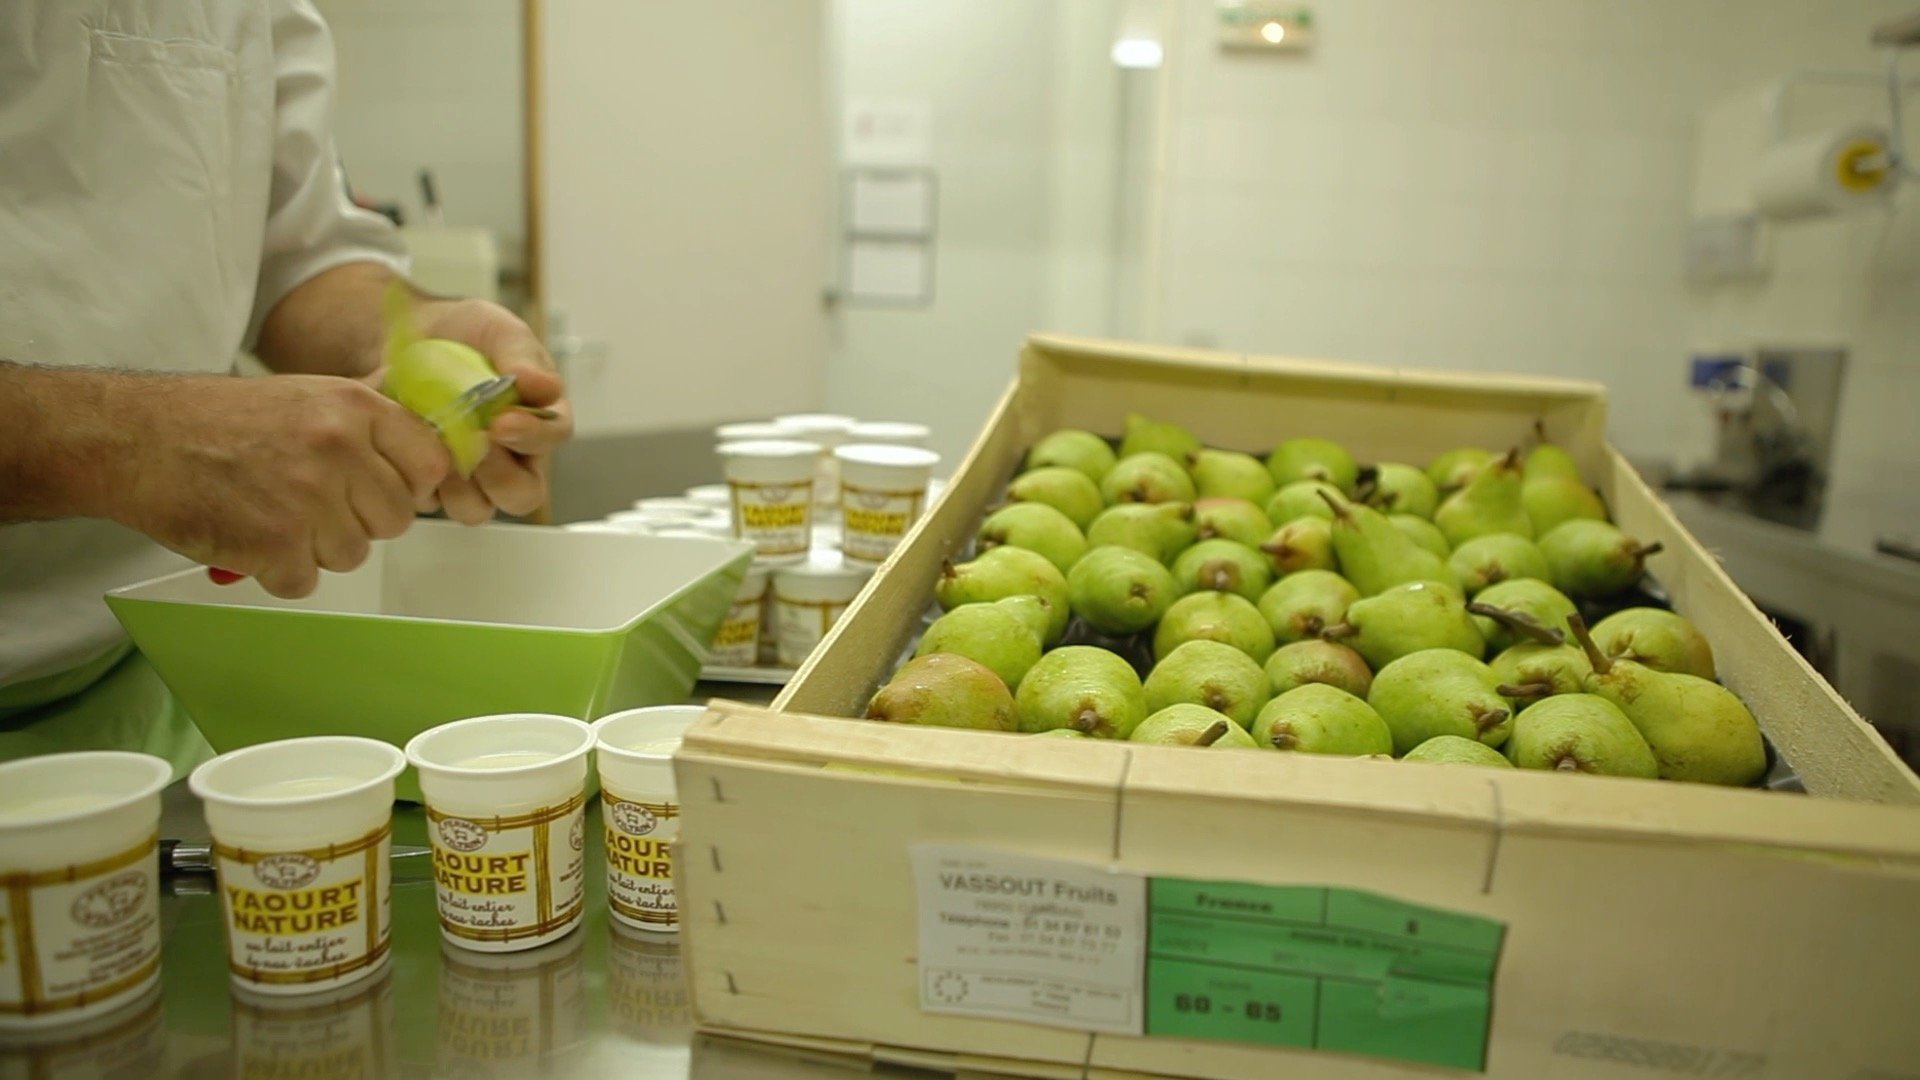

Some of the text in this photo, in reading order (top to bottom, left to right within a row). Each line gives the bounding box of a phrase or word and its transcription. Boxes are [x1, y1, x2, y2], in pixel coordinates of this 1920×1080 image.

[229, 880, 362, 912] YAOURT
[939, 873, 1119, 905] VASSOUT Fruits
[234, 903, 359, 934] NATURE
[1174, 992, 1211, 1014] 60
